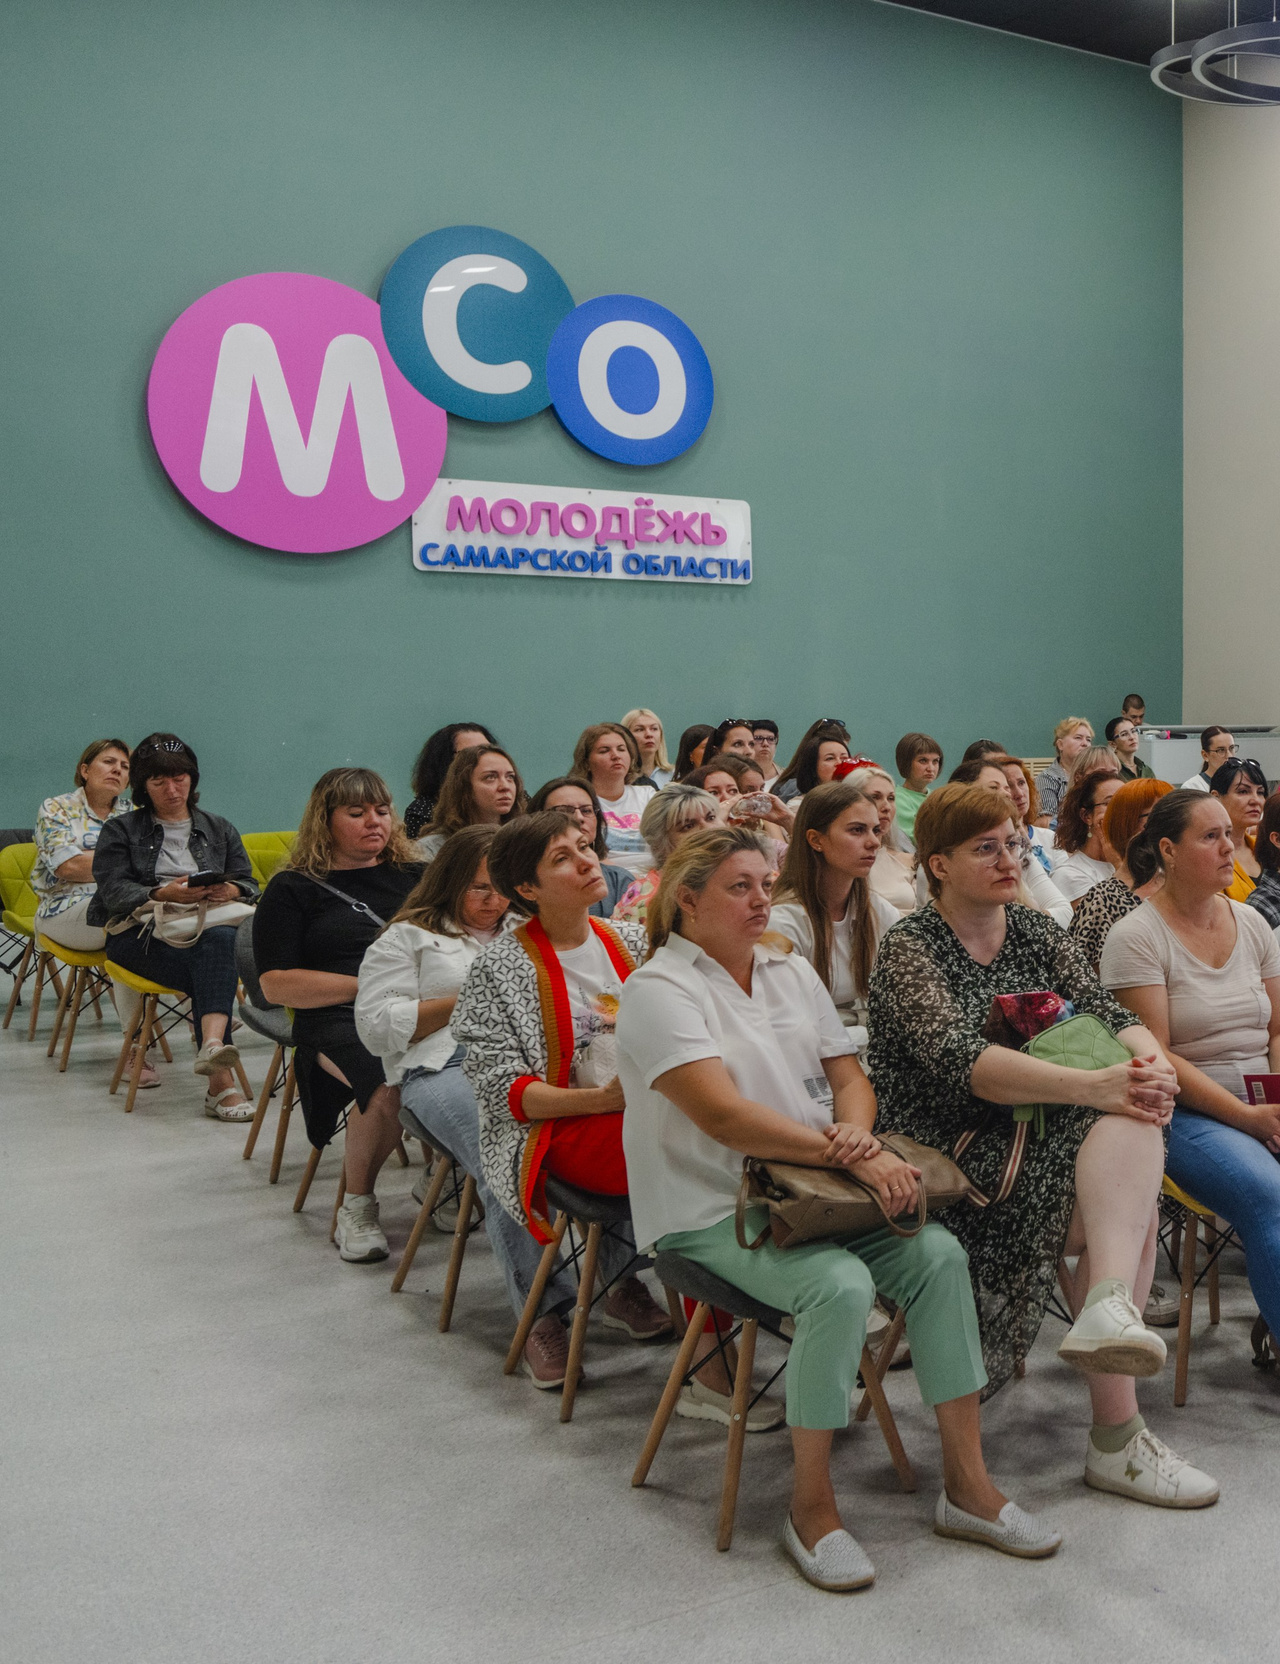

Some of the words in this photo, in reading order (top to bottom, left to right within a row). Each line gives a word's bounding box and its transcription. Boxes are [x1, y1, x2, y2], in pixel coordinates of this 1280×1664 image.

[446, 495, 728, 549] МОЛОДЁЖЬ
[419, 542, 613, 575] САМАРСКОЙ
[622, 552, 751, 582] ОБЛАСТИ
